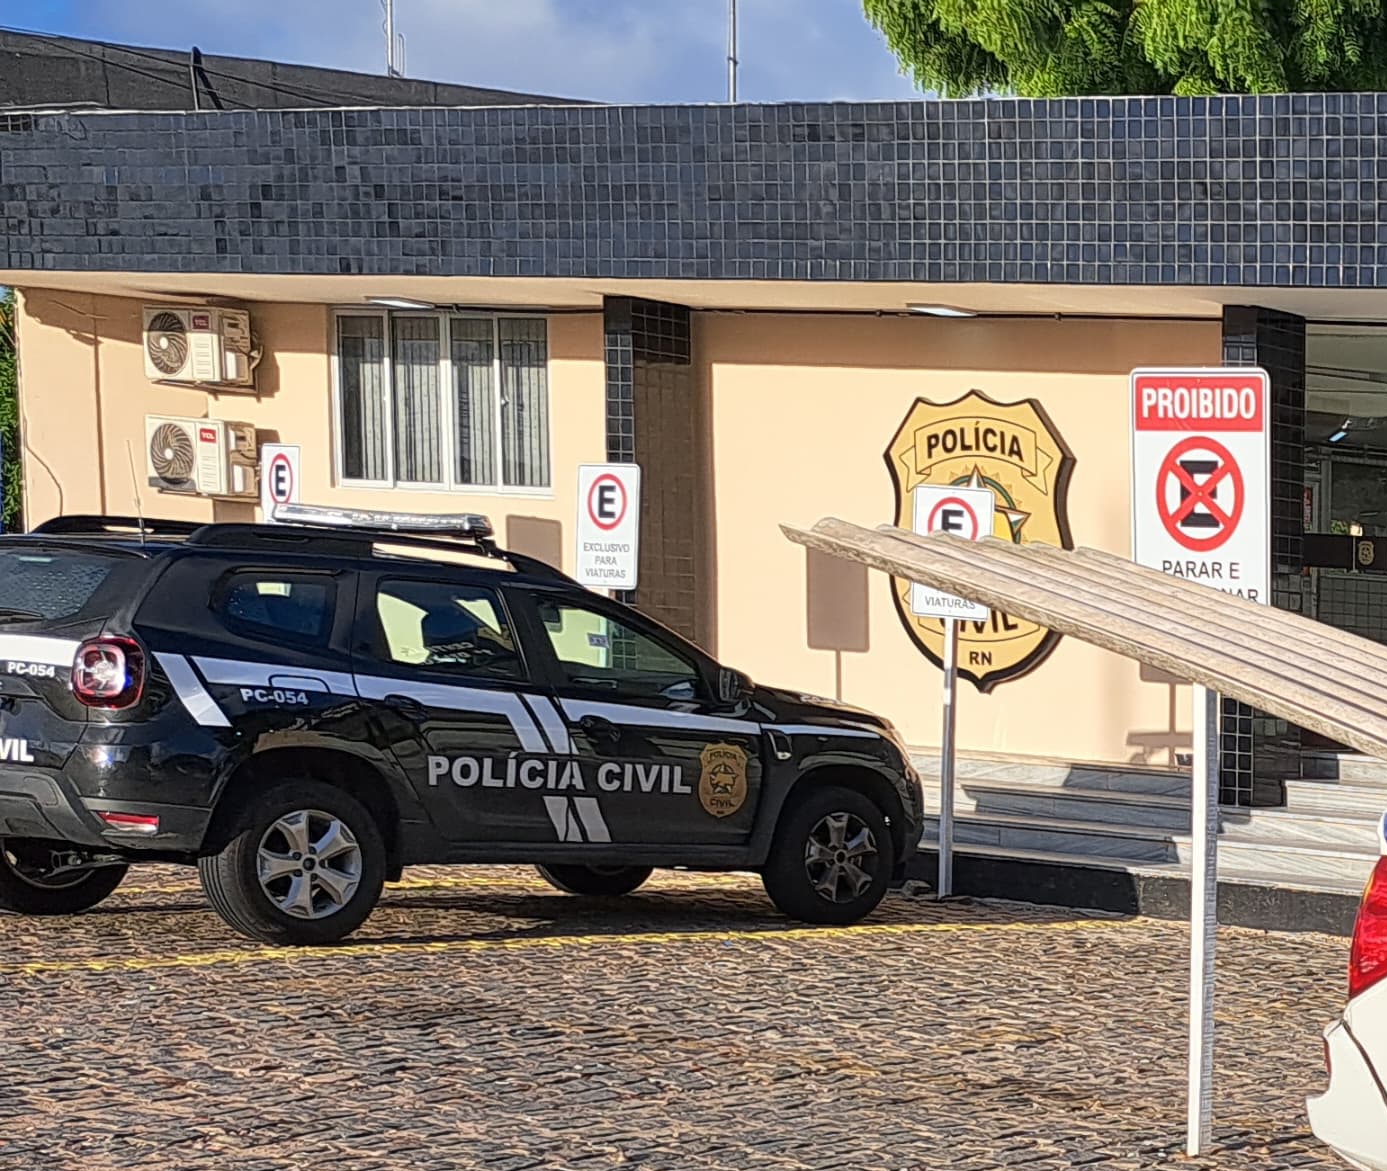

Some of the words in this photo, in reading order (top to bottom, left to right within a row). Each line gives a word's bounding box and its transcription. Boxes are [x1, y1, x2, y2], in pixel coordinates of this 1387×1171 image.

[1141, 387, 1257, 420] PROIBIDO
[926, 421, 1025, 463] POLÍCIA
[275, 464, 286, 497] E
[598, 485, 617, 519] E
[583, 542, 631, 553] EXCLUSIVO
[594, 555, 618, 566] PARA
[585, 568, 626, 579] VIATURAS
[1162, 560, 1223, 579] PARAR
[1229, 562, 1241, 580] E
[924, 595, 977, 611] VIATURAS
[969, 650, 993, 667] RN
[7, 661, 56, 678] PC-054
[239, 687, 309, 705] PC-054
[427, 751, 586, 791] POLÍCIA
[597, 762, 692, 794] CIVIL
